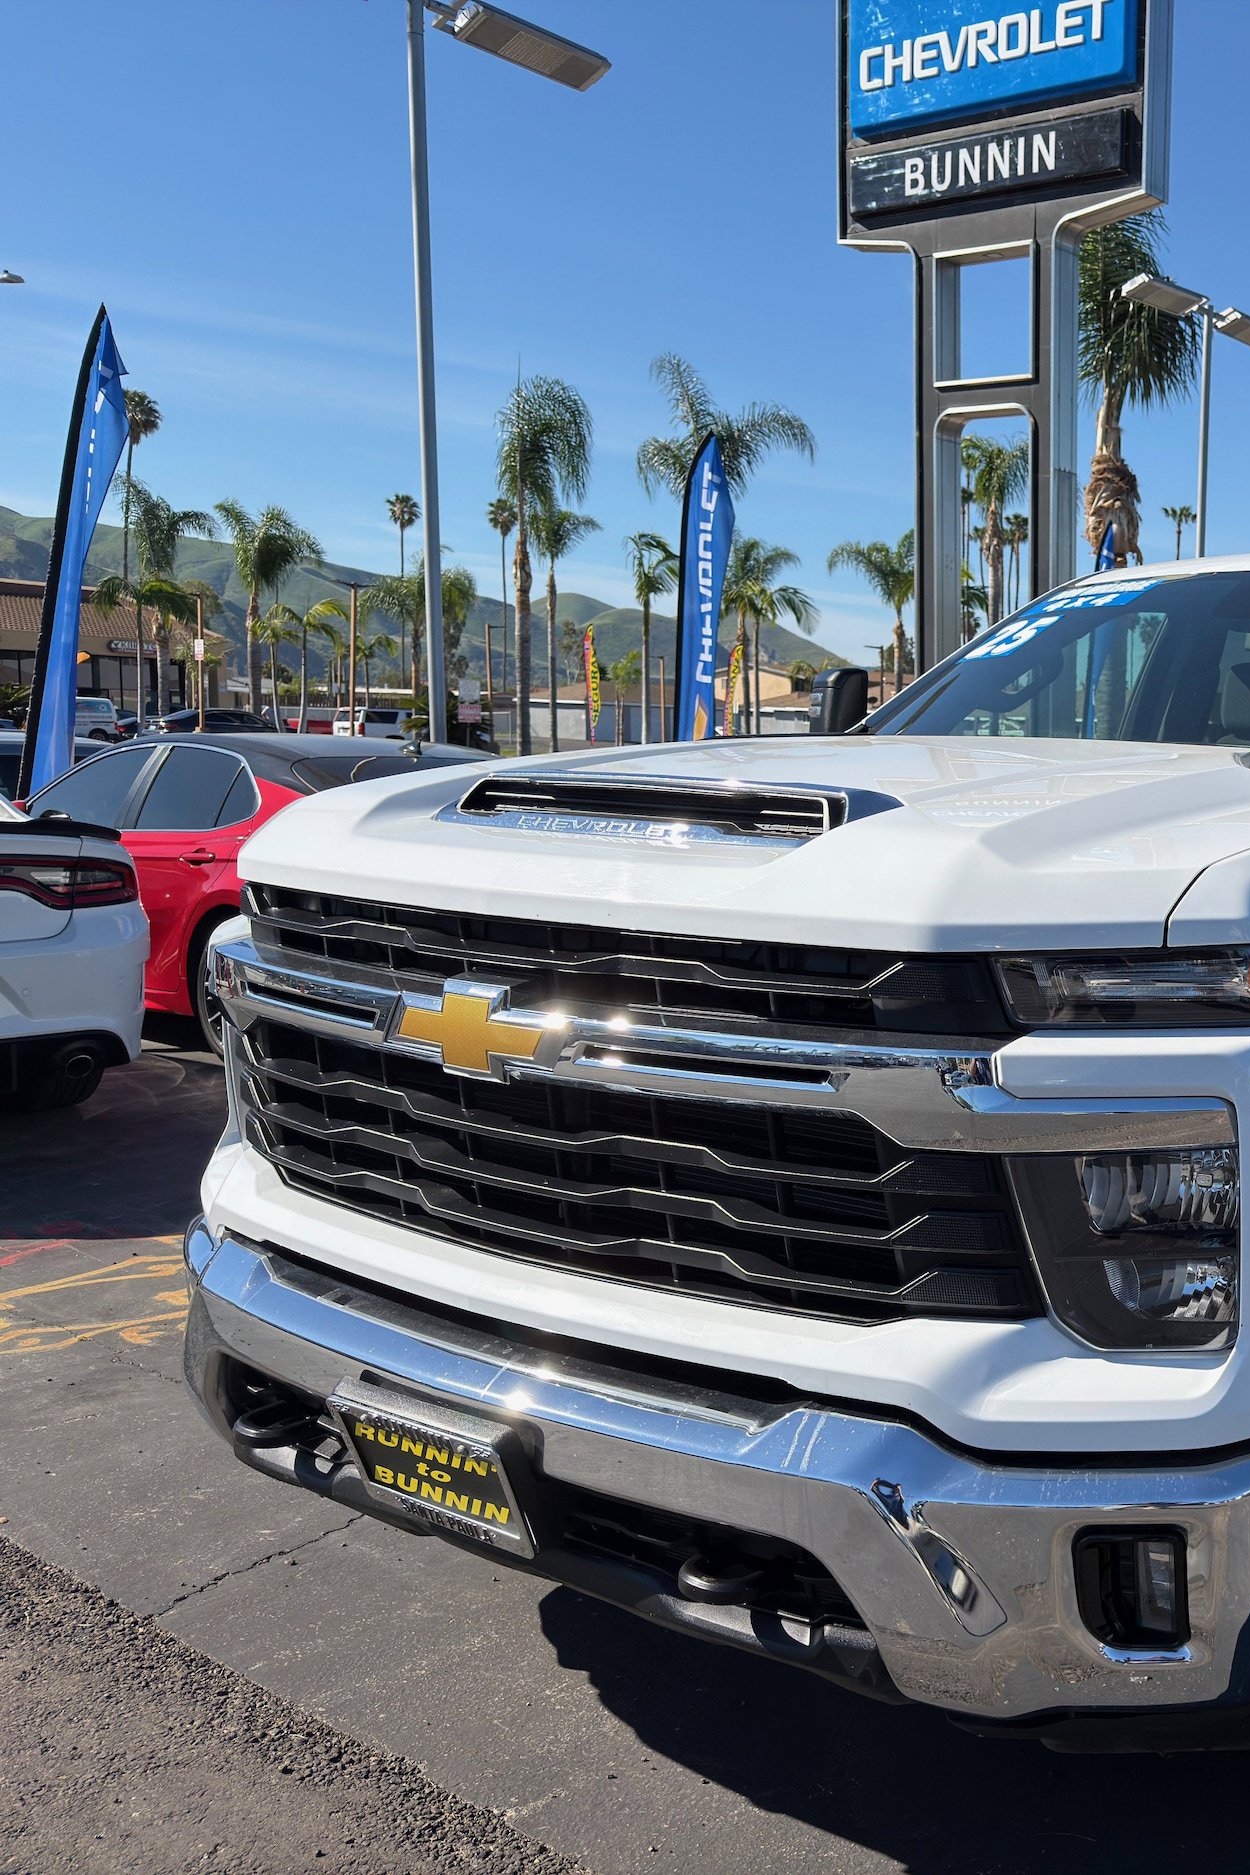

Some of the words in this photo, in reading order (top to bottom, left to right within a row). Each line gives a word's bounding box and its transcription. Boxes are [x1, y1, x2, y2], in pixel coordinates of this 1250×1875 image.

[859, 0, 1113, 92] CHEVROLET
[904, 131, 1056, 197] BUNNIN
[374, 1465, 510, 1525] BUNNIN
[416, 1462, 451, 1483] to
